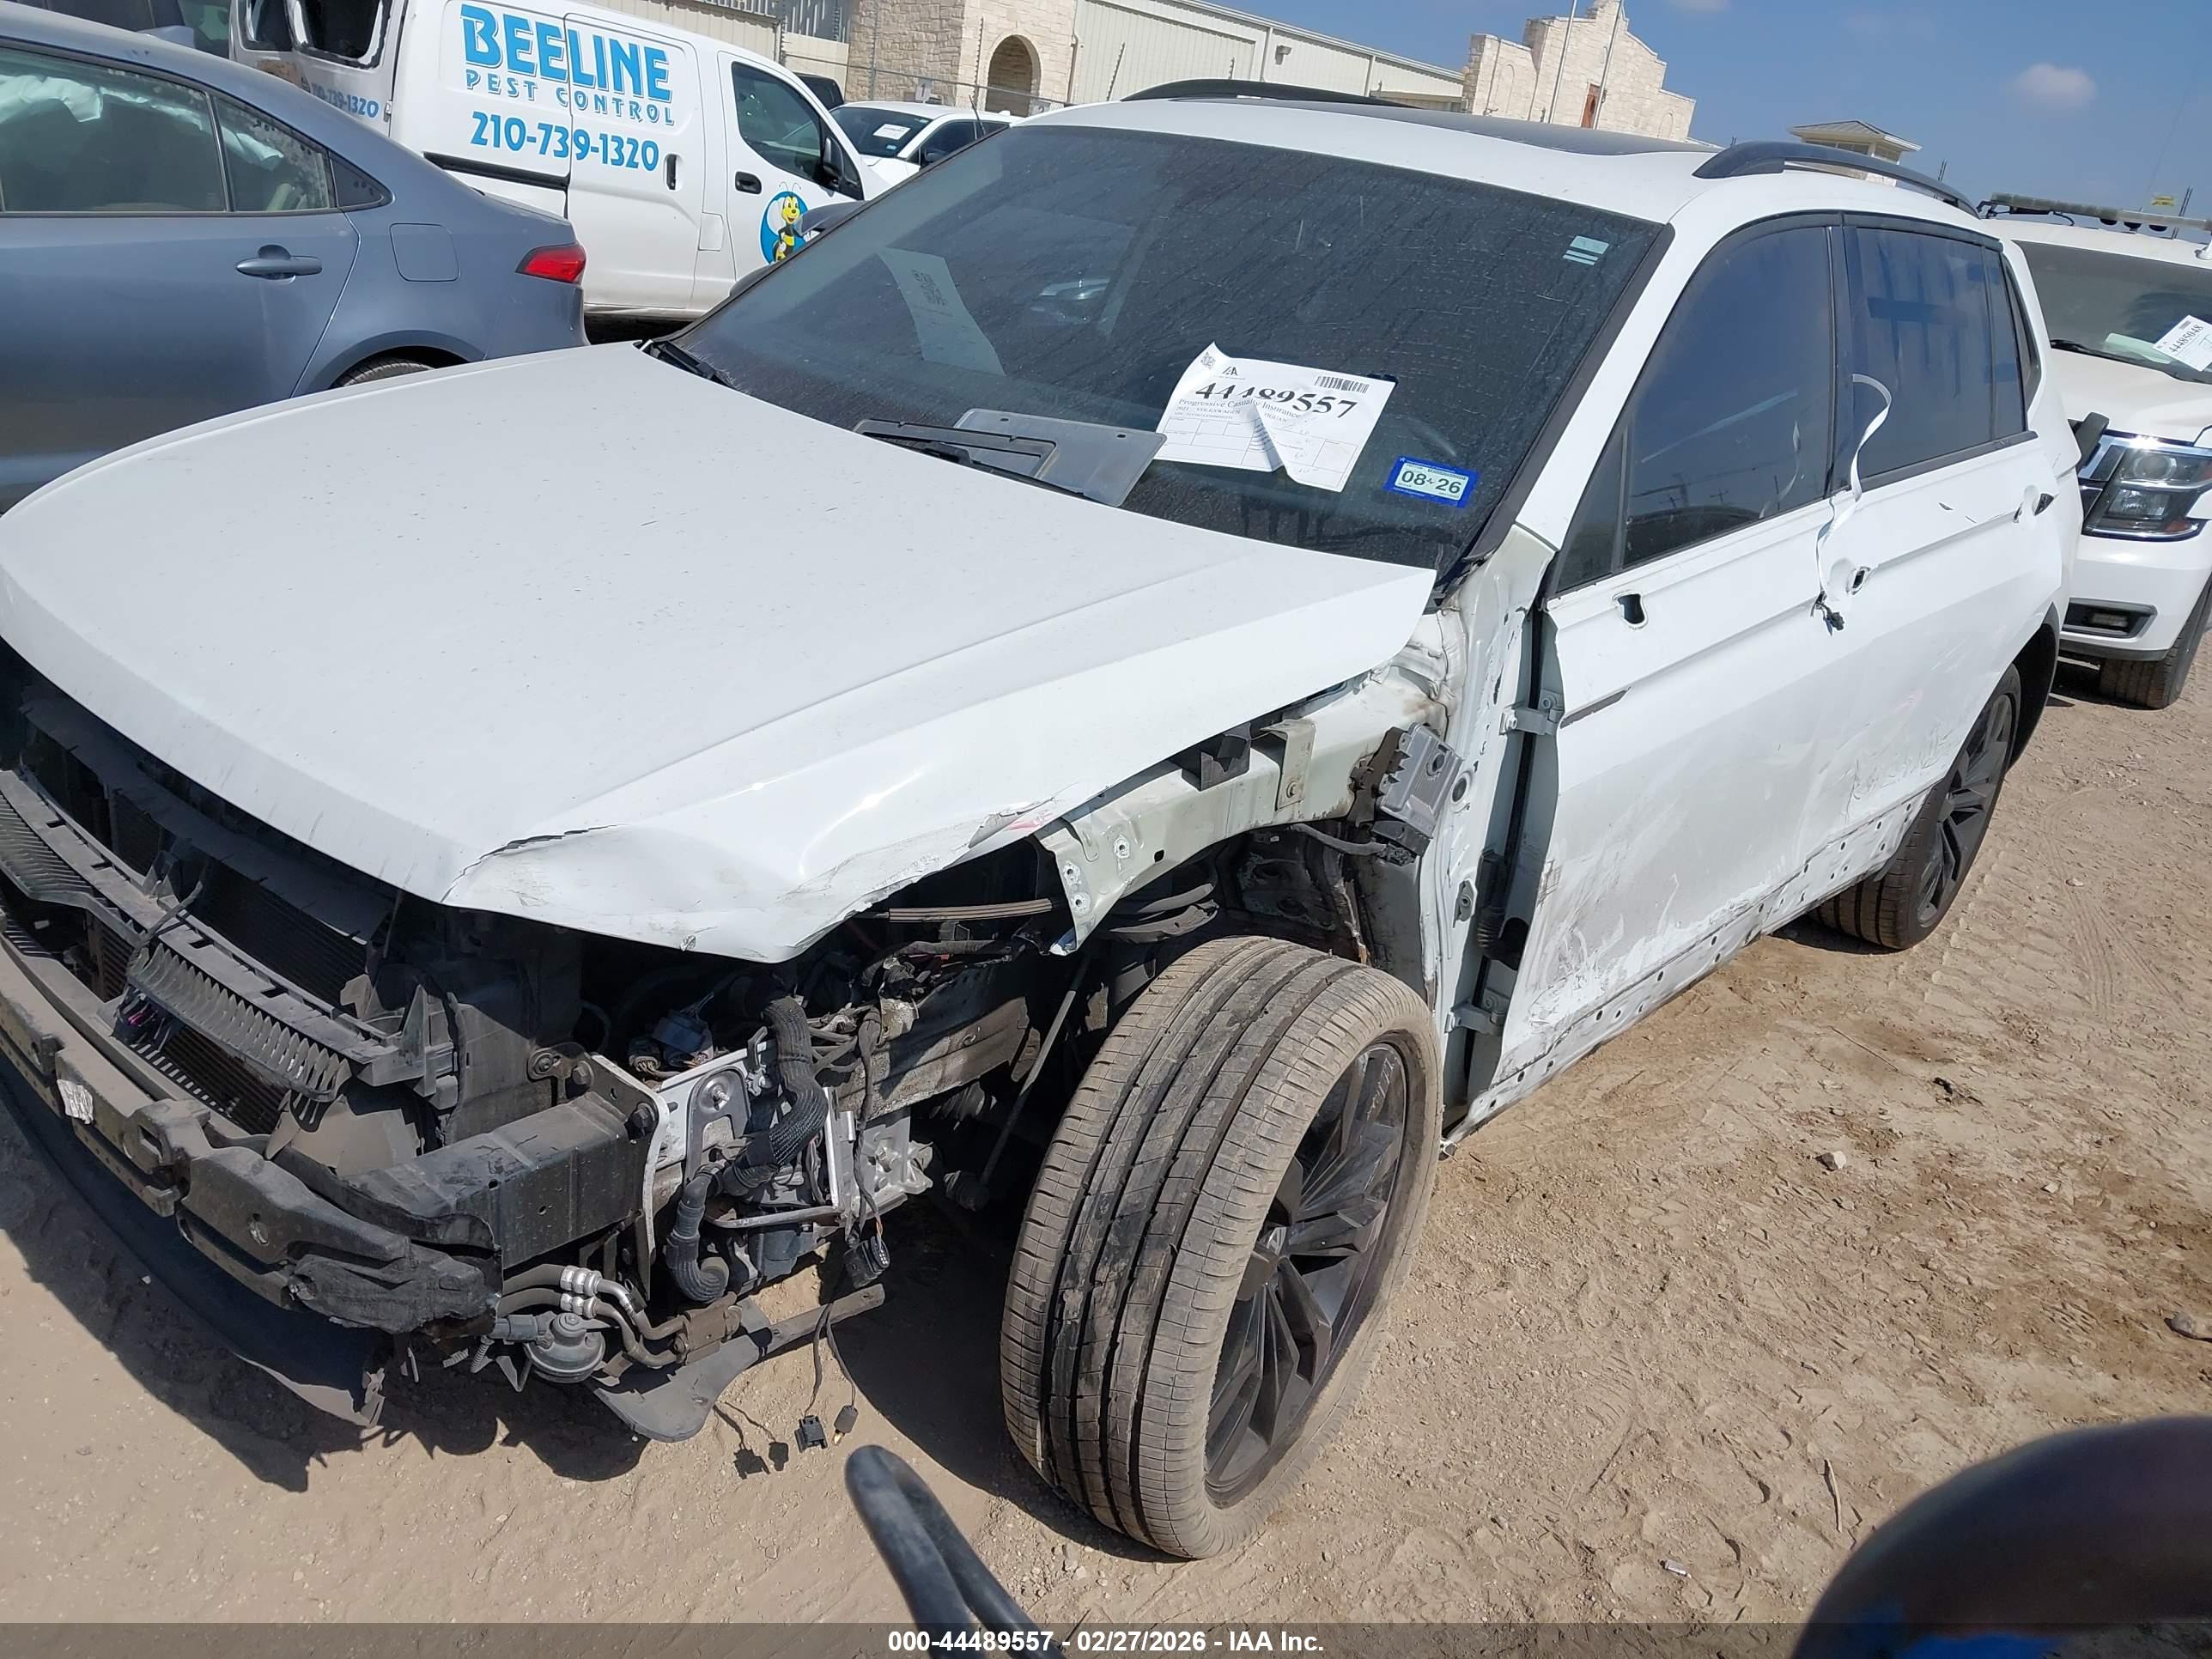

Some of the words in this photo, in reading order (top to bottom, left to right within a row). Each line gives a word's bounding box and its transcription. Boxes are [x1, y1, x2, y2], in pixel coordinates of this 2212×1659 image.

[460, 3, 672, 103] BEELINE
[465, 69, 538, 101] PEST
[556, 87, 675, 126] CONTROL
[470, 111, 659, 172] 210-739-1320
[1178, 398, 1226, 407] Progressive
[1401, 470, 1428, 486] 08
[1435, 477, 1462, 494] 26
